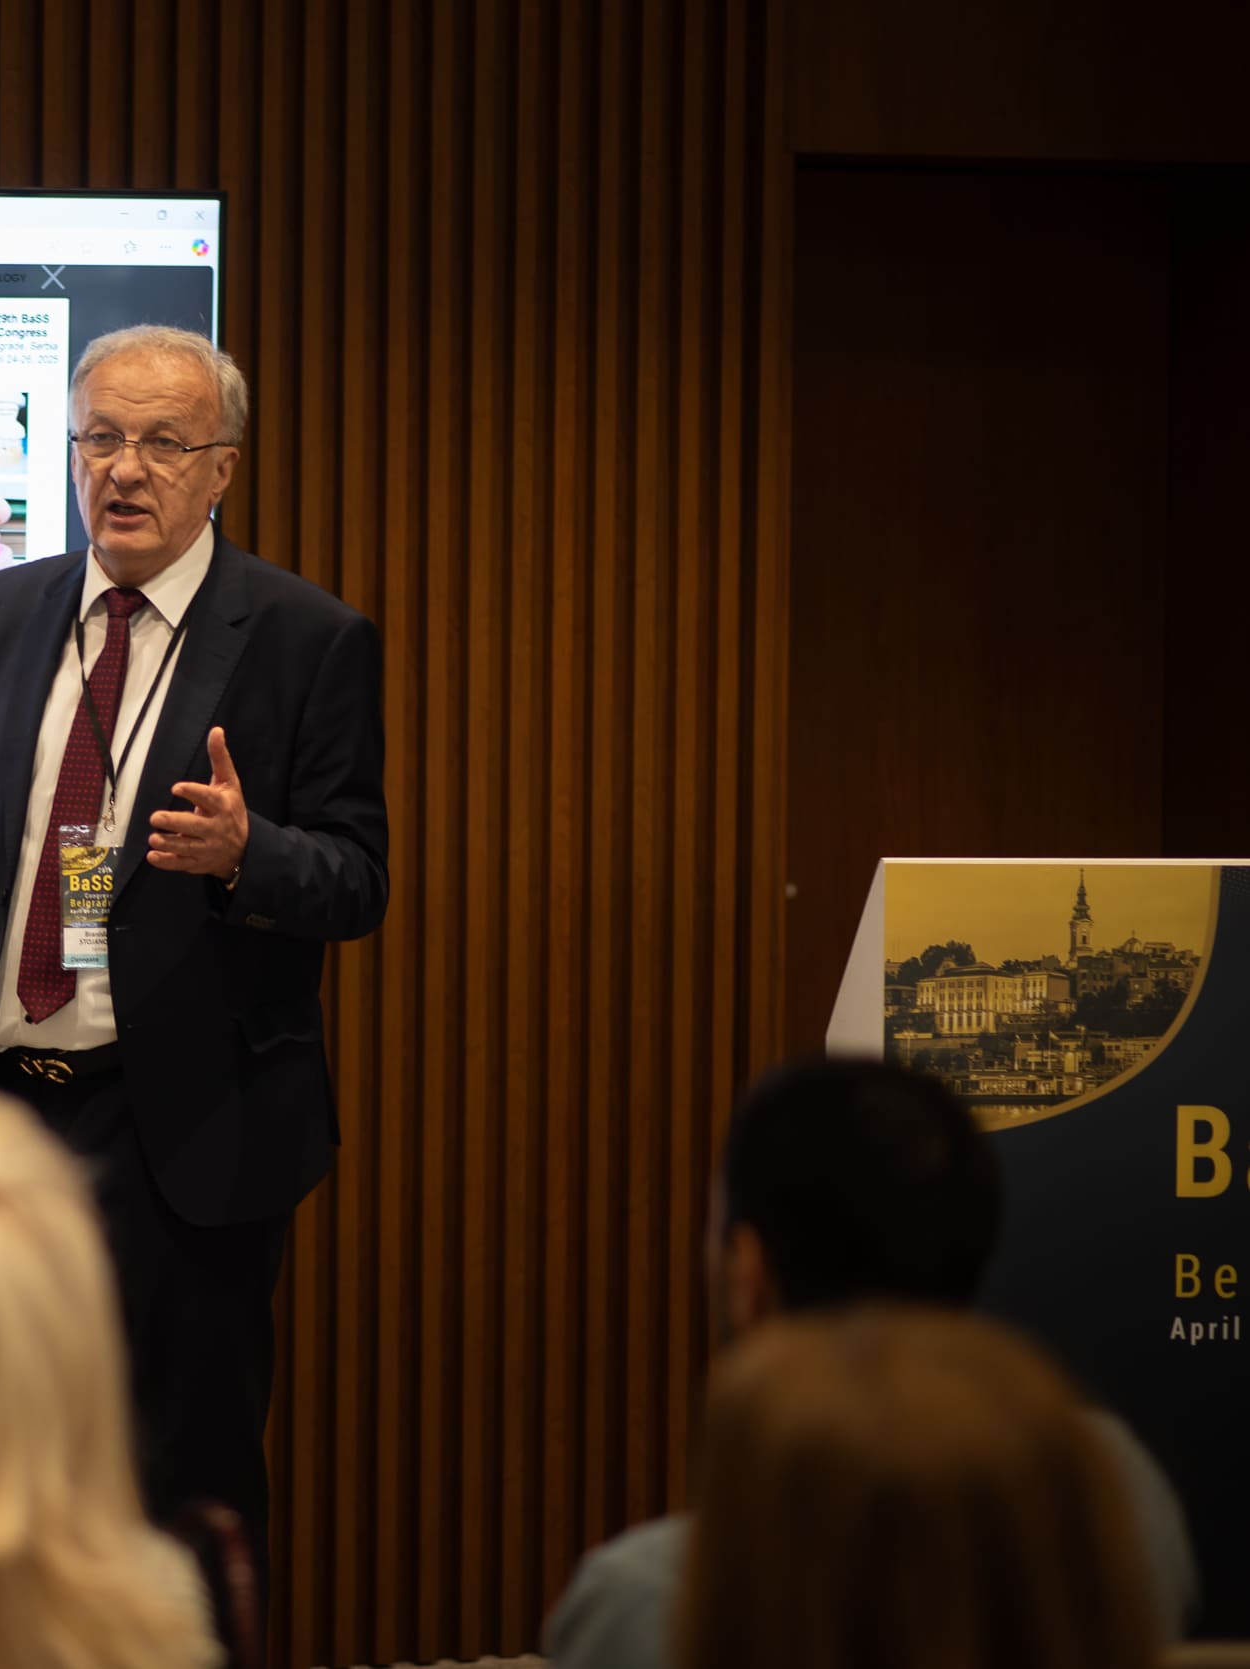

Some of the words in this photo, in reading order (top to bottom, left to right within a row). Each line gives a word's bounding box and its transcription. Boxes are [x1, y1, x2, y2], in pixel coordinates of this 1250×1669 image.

[21, 313, 50, 324] BaSS
[70, 874, 113, 892] BaSS
[1169, 1315, 1241, 1346] April
